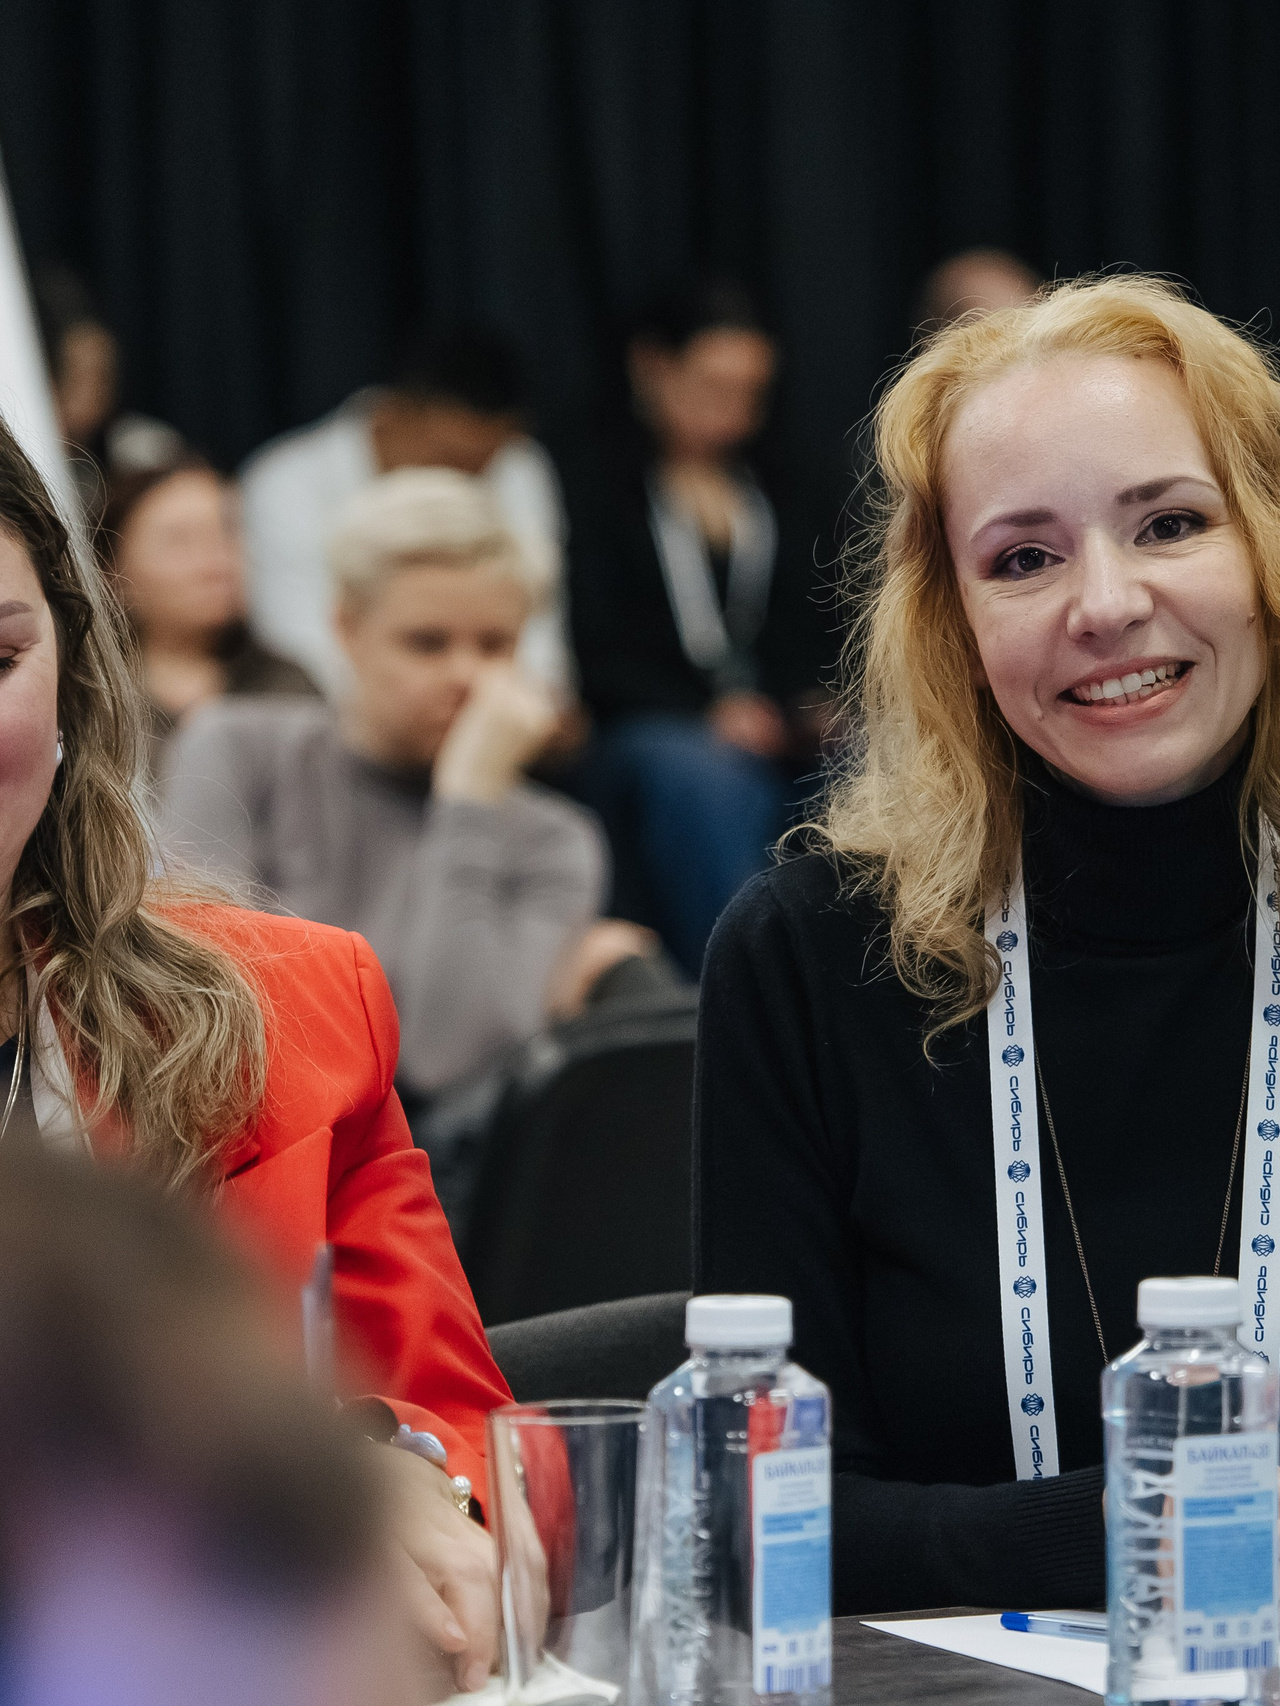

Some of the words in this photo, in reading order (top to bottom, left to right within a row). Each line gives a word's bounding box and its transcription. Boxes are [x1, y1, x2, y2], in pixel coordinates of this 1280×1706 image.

[1003, 960, 1016, 1037] сибирь
[1265, 1035, 1279, 1111] сибирь
[1009, 1075, 1023, 1152] сибирь
[1260, 1149, 1274, 1226] сибирь
[1015, 1191, 1028, 1268] сибирь
[1253, 1265, 1268, 1342] сибирь
[1021, 1307, 1034, 1385] сибирь
[1029, 1424, 1043, 1480] сиби
